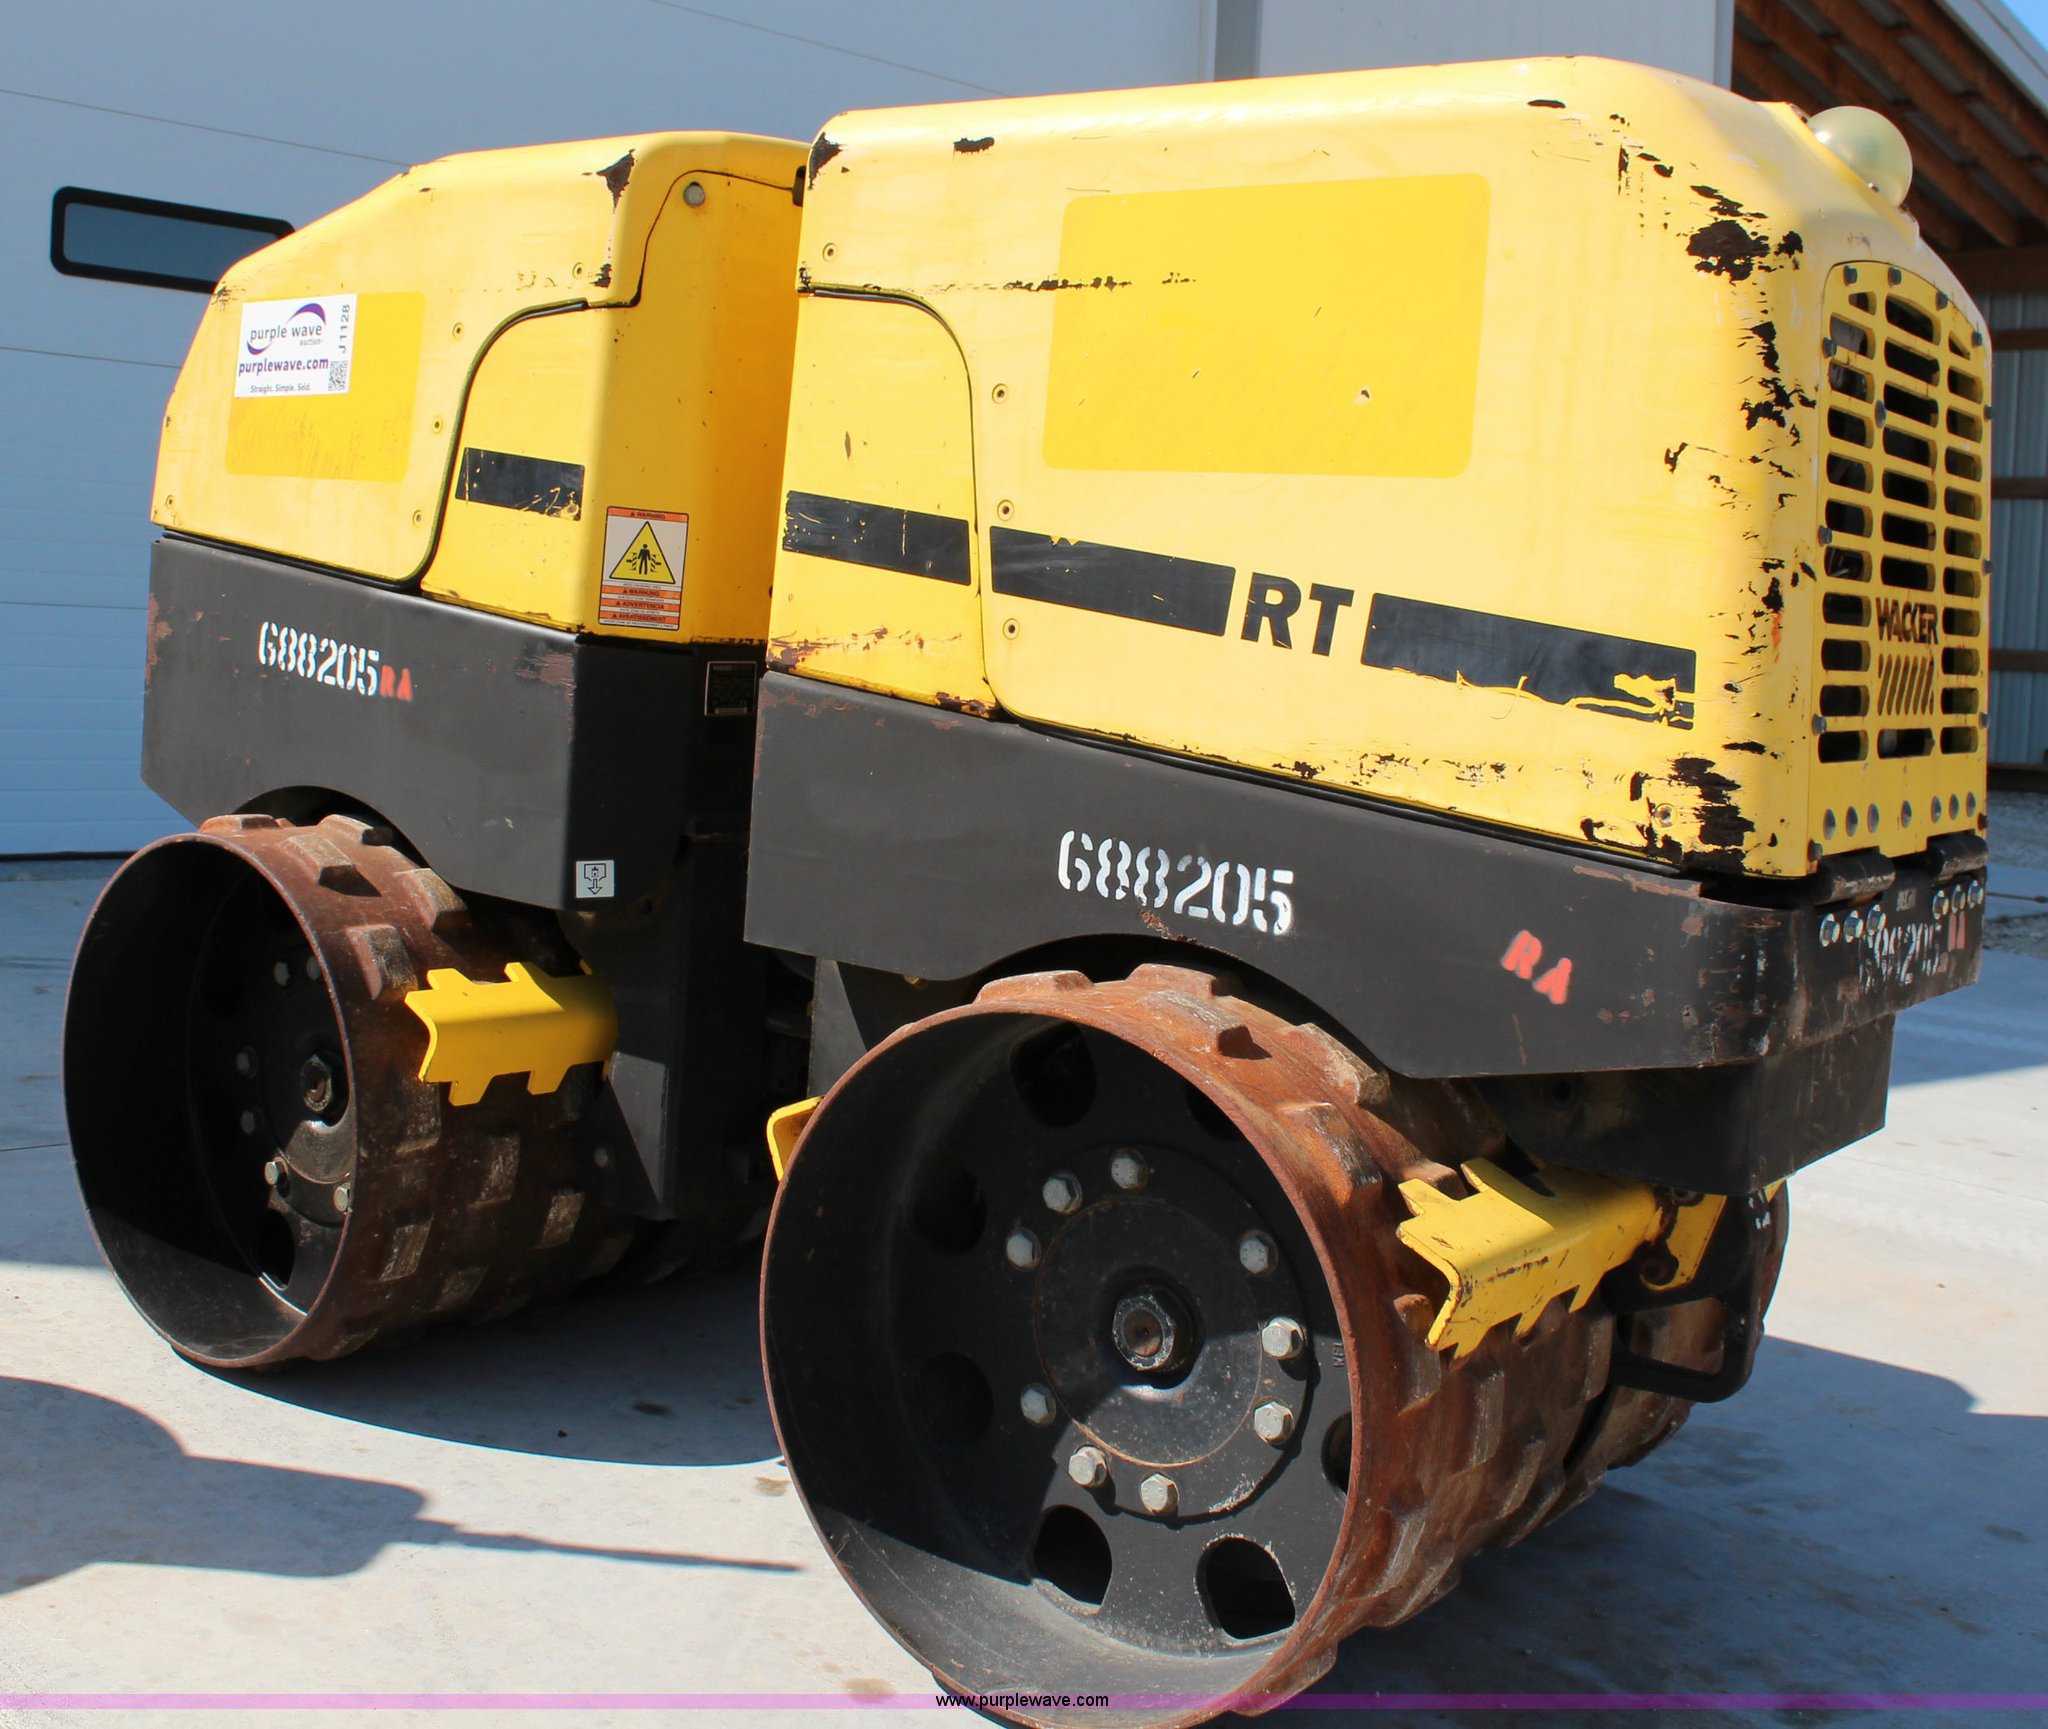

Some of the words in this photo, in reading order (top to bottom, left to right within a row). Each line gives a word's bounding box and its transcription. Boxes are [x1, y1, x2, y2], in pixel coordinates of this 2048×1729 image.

[250, 325, 287, 343] purple
[291, 324, 323, 337] wave
[238, 357, 329, 376] purplewave.com
[636, 511, 666, 521] WARNING
[1241, 572, 1355, 656] RT
[1875, 597, 1939, 645] WACKER
[258, 621, 380, 696] 688205
[1058, 830, 1294, 936] 688205
[1500, 930, 1573, 1005] RA
